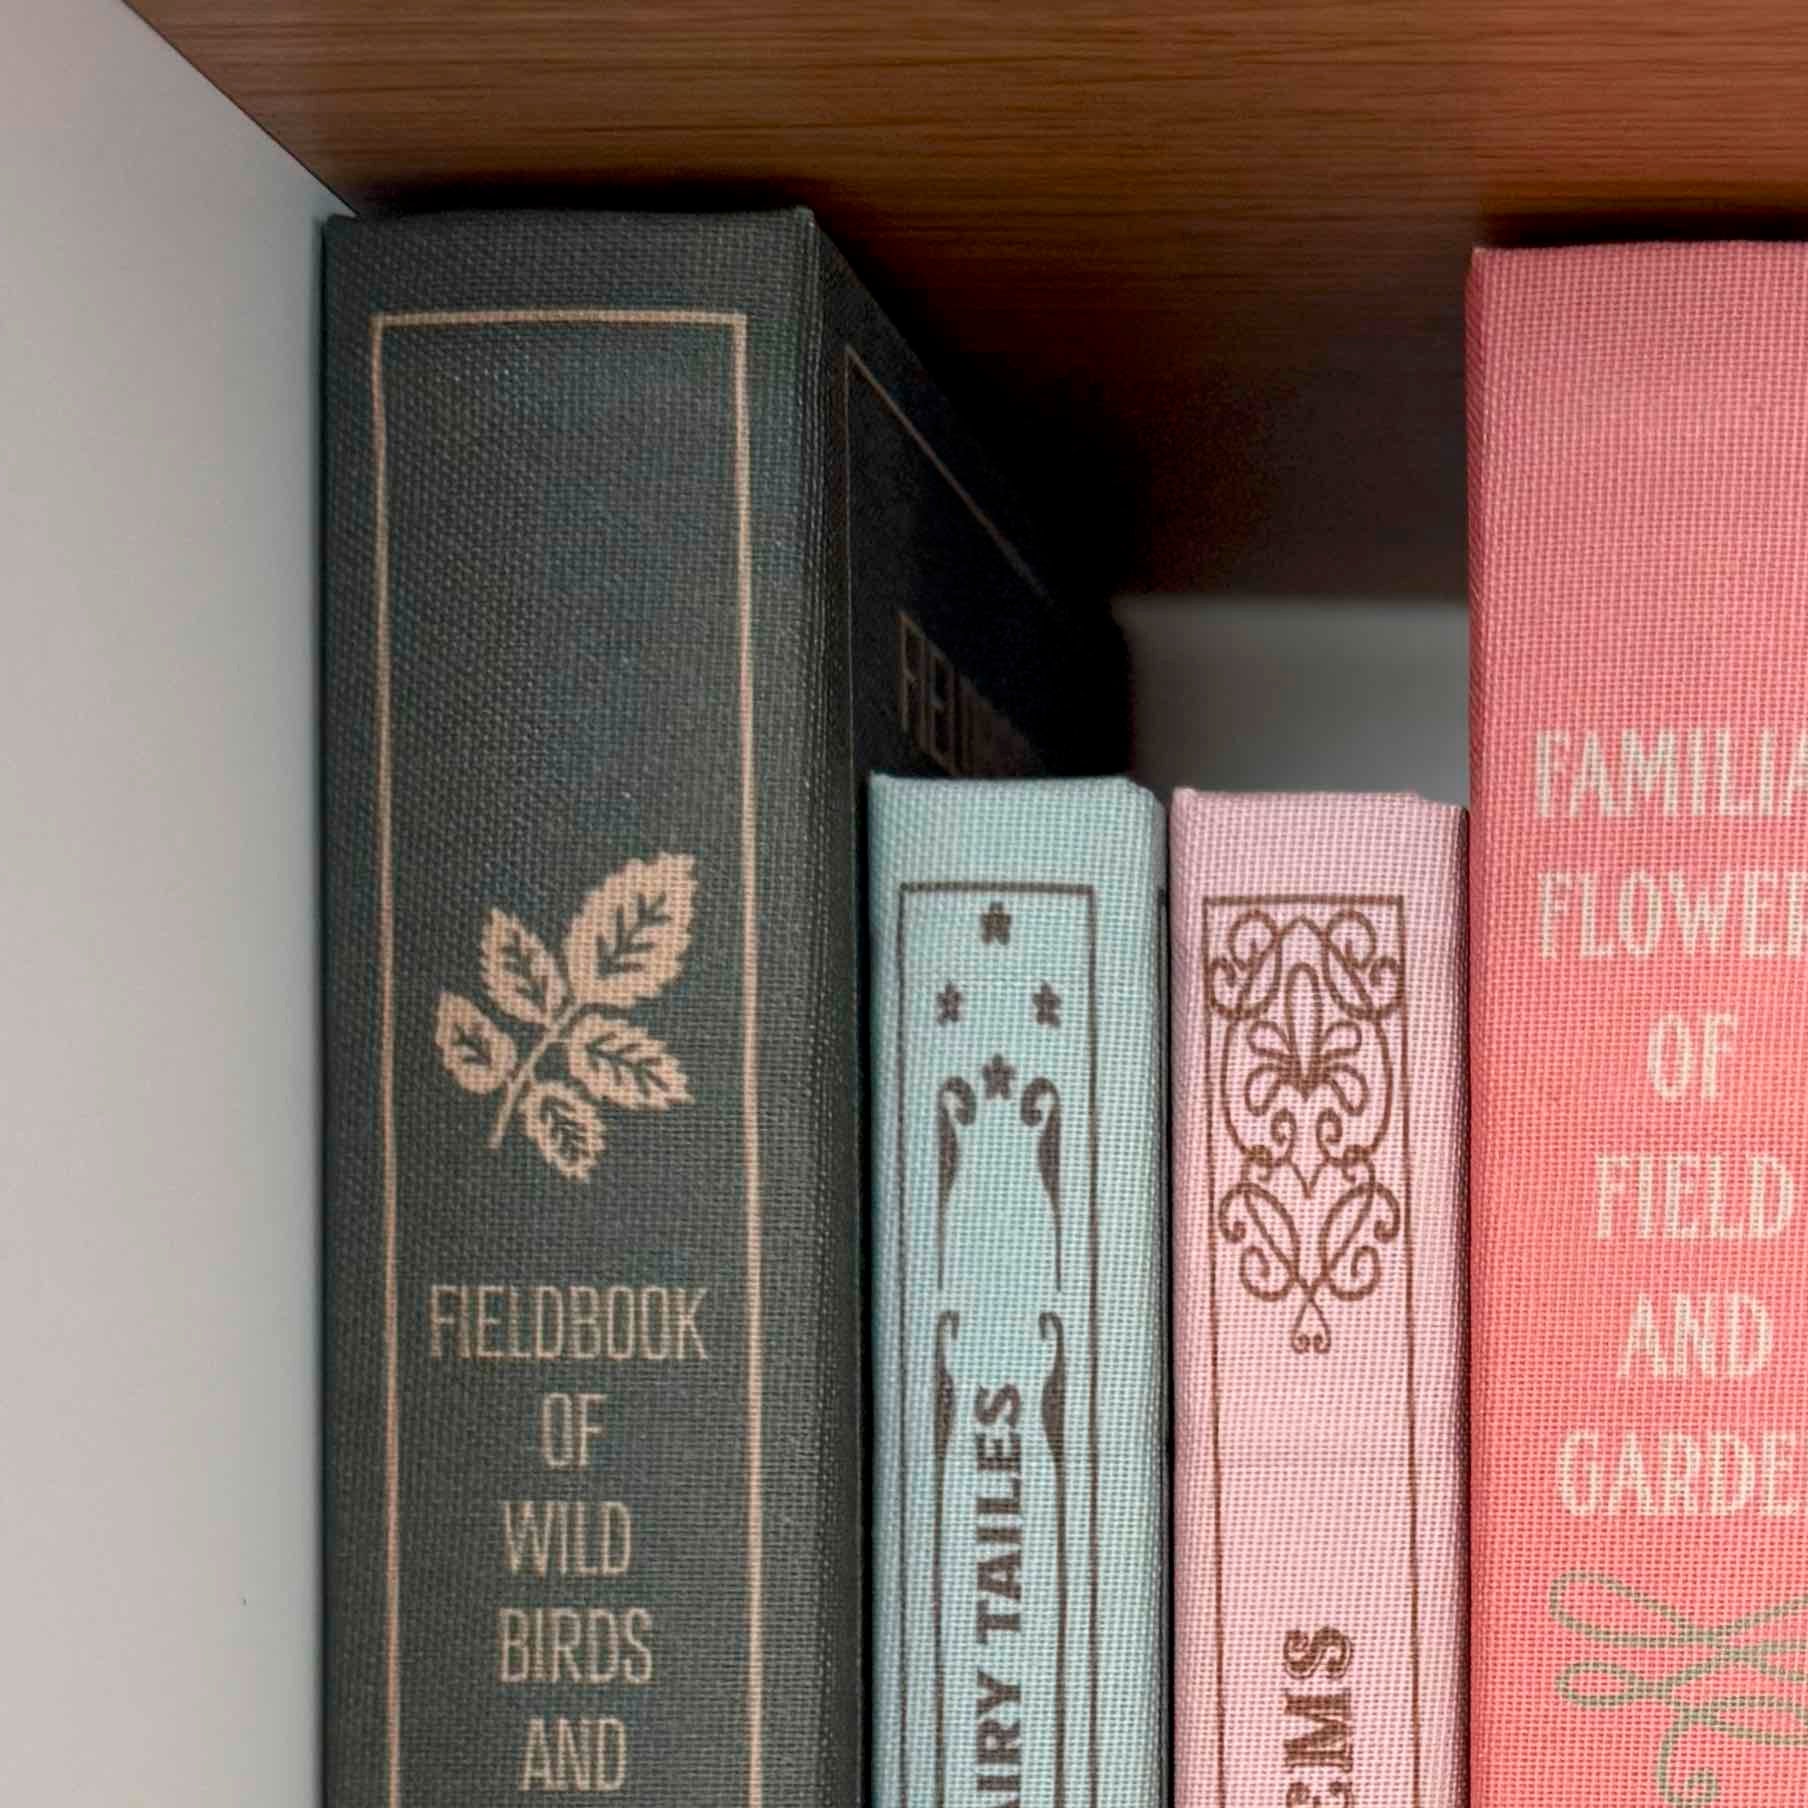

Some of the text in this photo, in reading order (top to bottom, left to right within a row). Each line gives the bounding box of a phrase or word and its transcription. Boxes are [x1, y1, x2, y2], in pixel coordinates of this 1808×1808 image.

[1647, 1012, 1738, 1103] OF
[1596, 1154, 1795, 1242] FIELD
[430, 1285, 709, 1361] FIELDBOOK
[1616, 1292, 1774, 1380] AND
[541, 1393, 607, 1470] OF
[502, 1501, 632, 1577] WILD
[974, 1380, 1026, 1643] TAILES
[500, 1608, 654, 1684] BIRDS
[518, 1719, 627, 1791] AND
